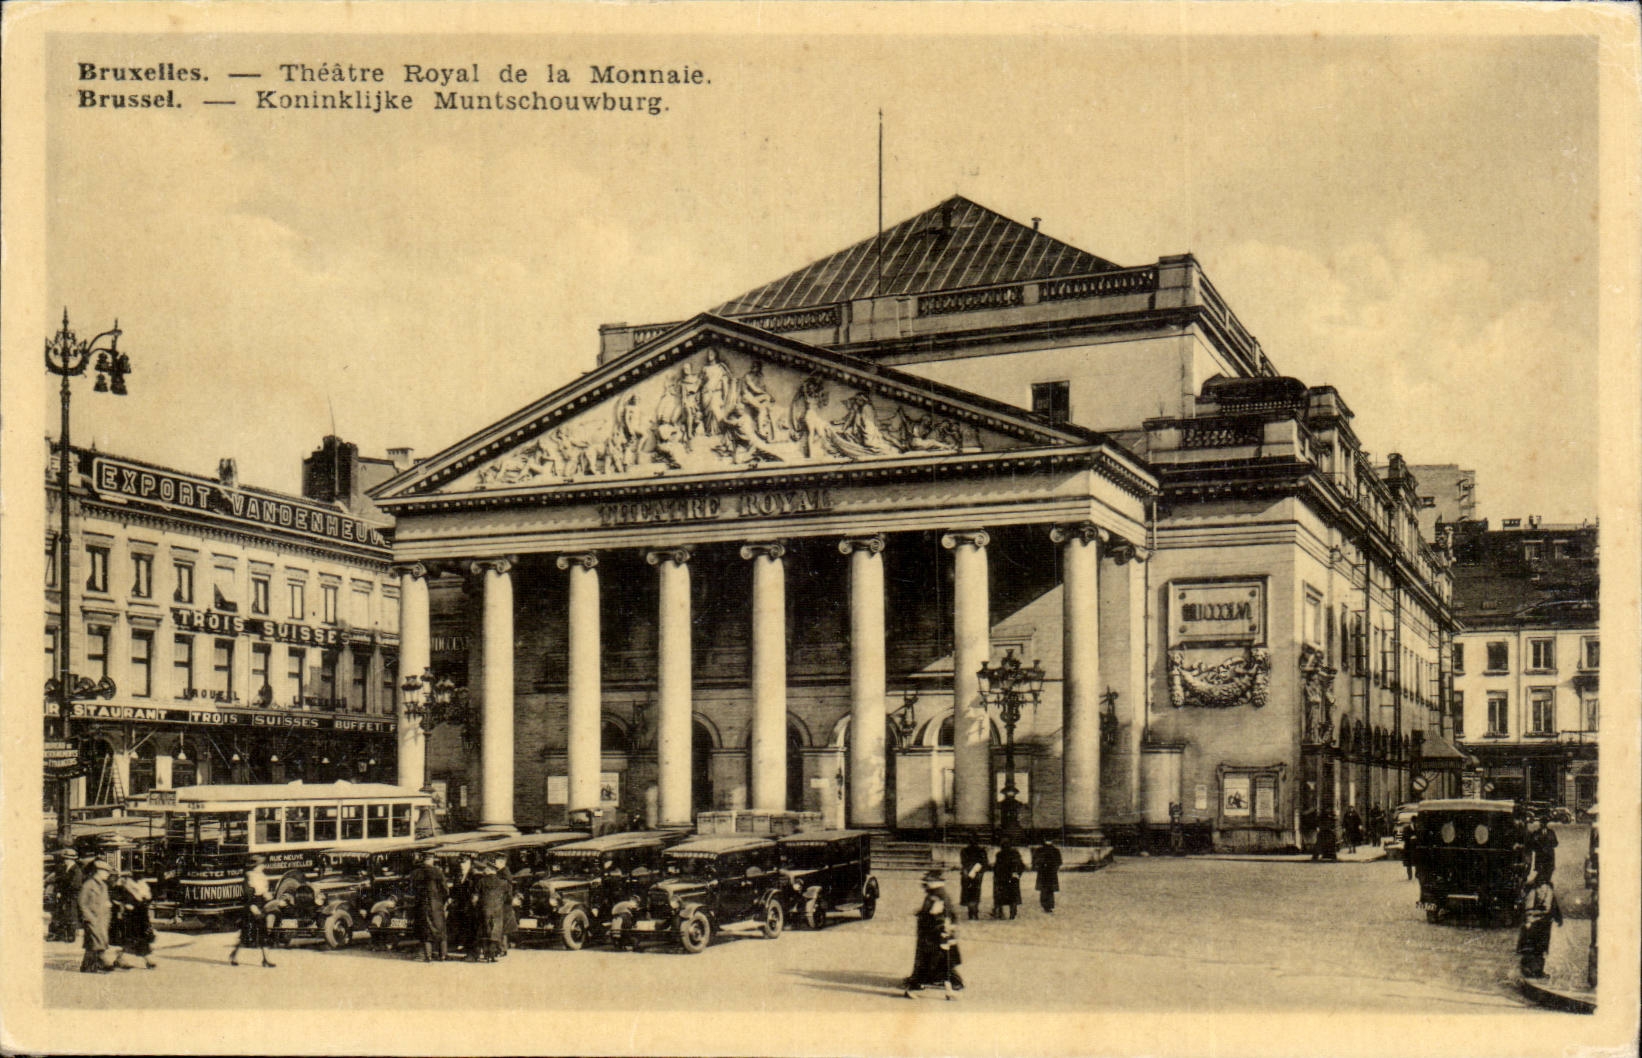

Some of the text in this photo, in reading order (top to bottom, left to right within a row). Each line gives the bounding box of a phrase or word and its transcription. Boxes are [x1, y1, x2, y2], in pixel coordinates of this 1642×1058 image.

[102, 464, 210, 508] EXPORT
[738, 489, 834, 518] ROYAL
[179, 610, 350, 645] TROIS SUISSES
[49, 703, 168, 720] RSTAURANT
[191, 712, 238, 724] TROIS
[254, 714, 319, 728] SUISSES
[335, 720, 380, 732] BUFFET
